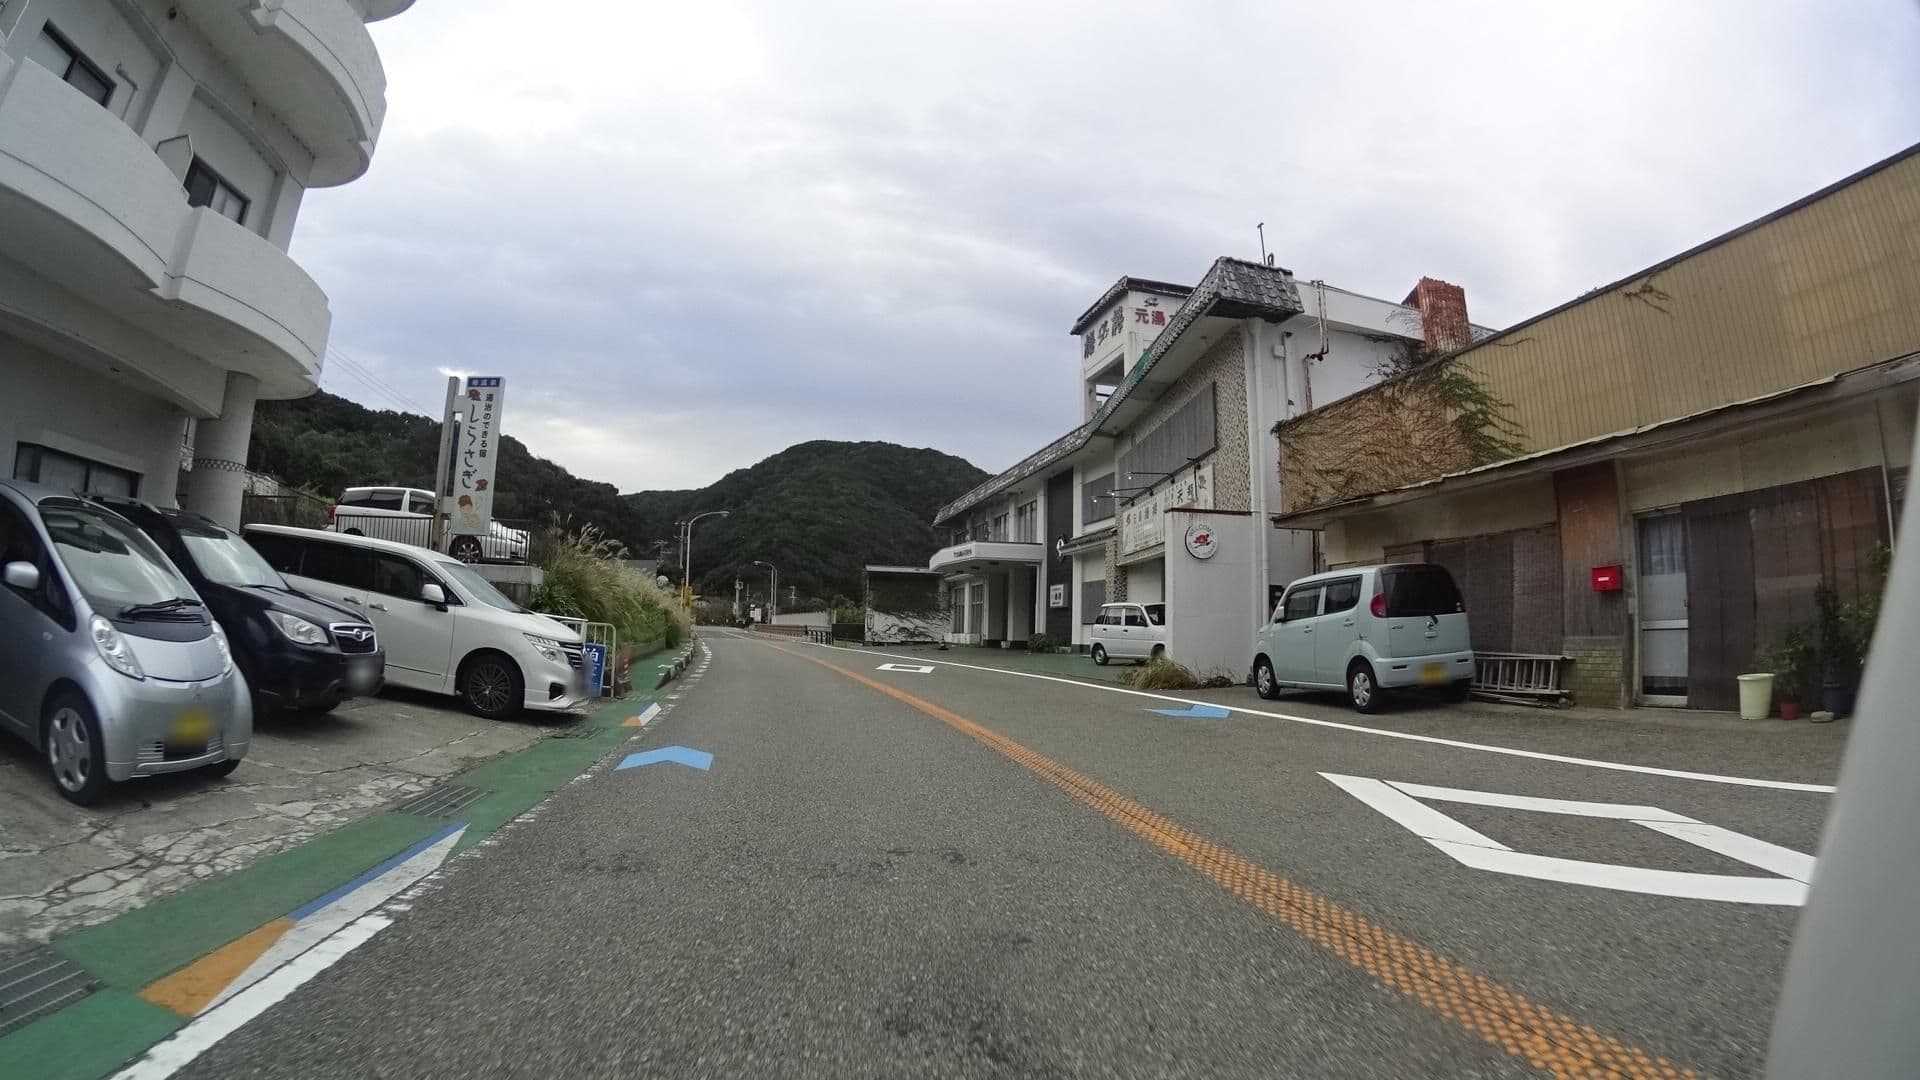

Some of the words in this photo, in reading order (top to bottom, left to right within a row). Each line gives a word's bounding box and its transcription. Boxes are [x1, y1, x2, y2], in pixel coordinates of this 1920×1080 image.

[1135, 308, 1165, 326] 元湯
[462, 404, 480, 489] しらさぎ
